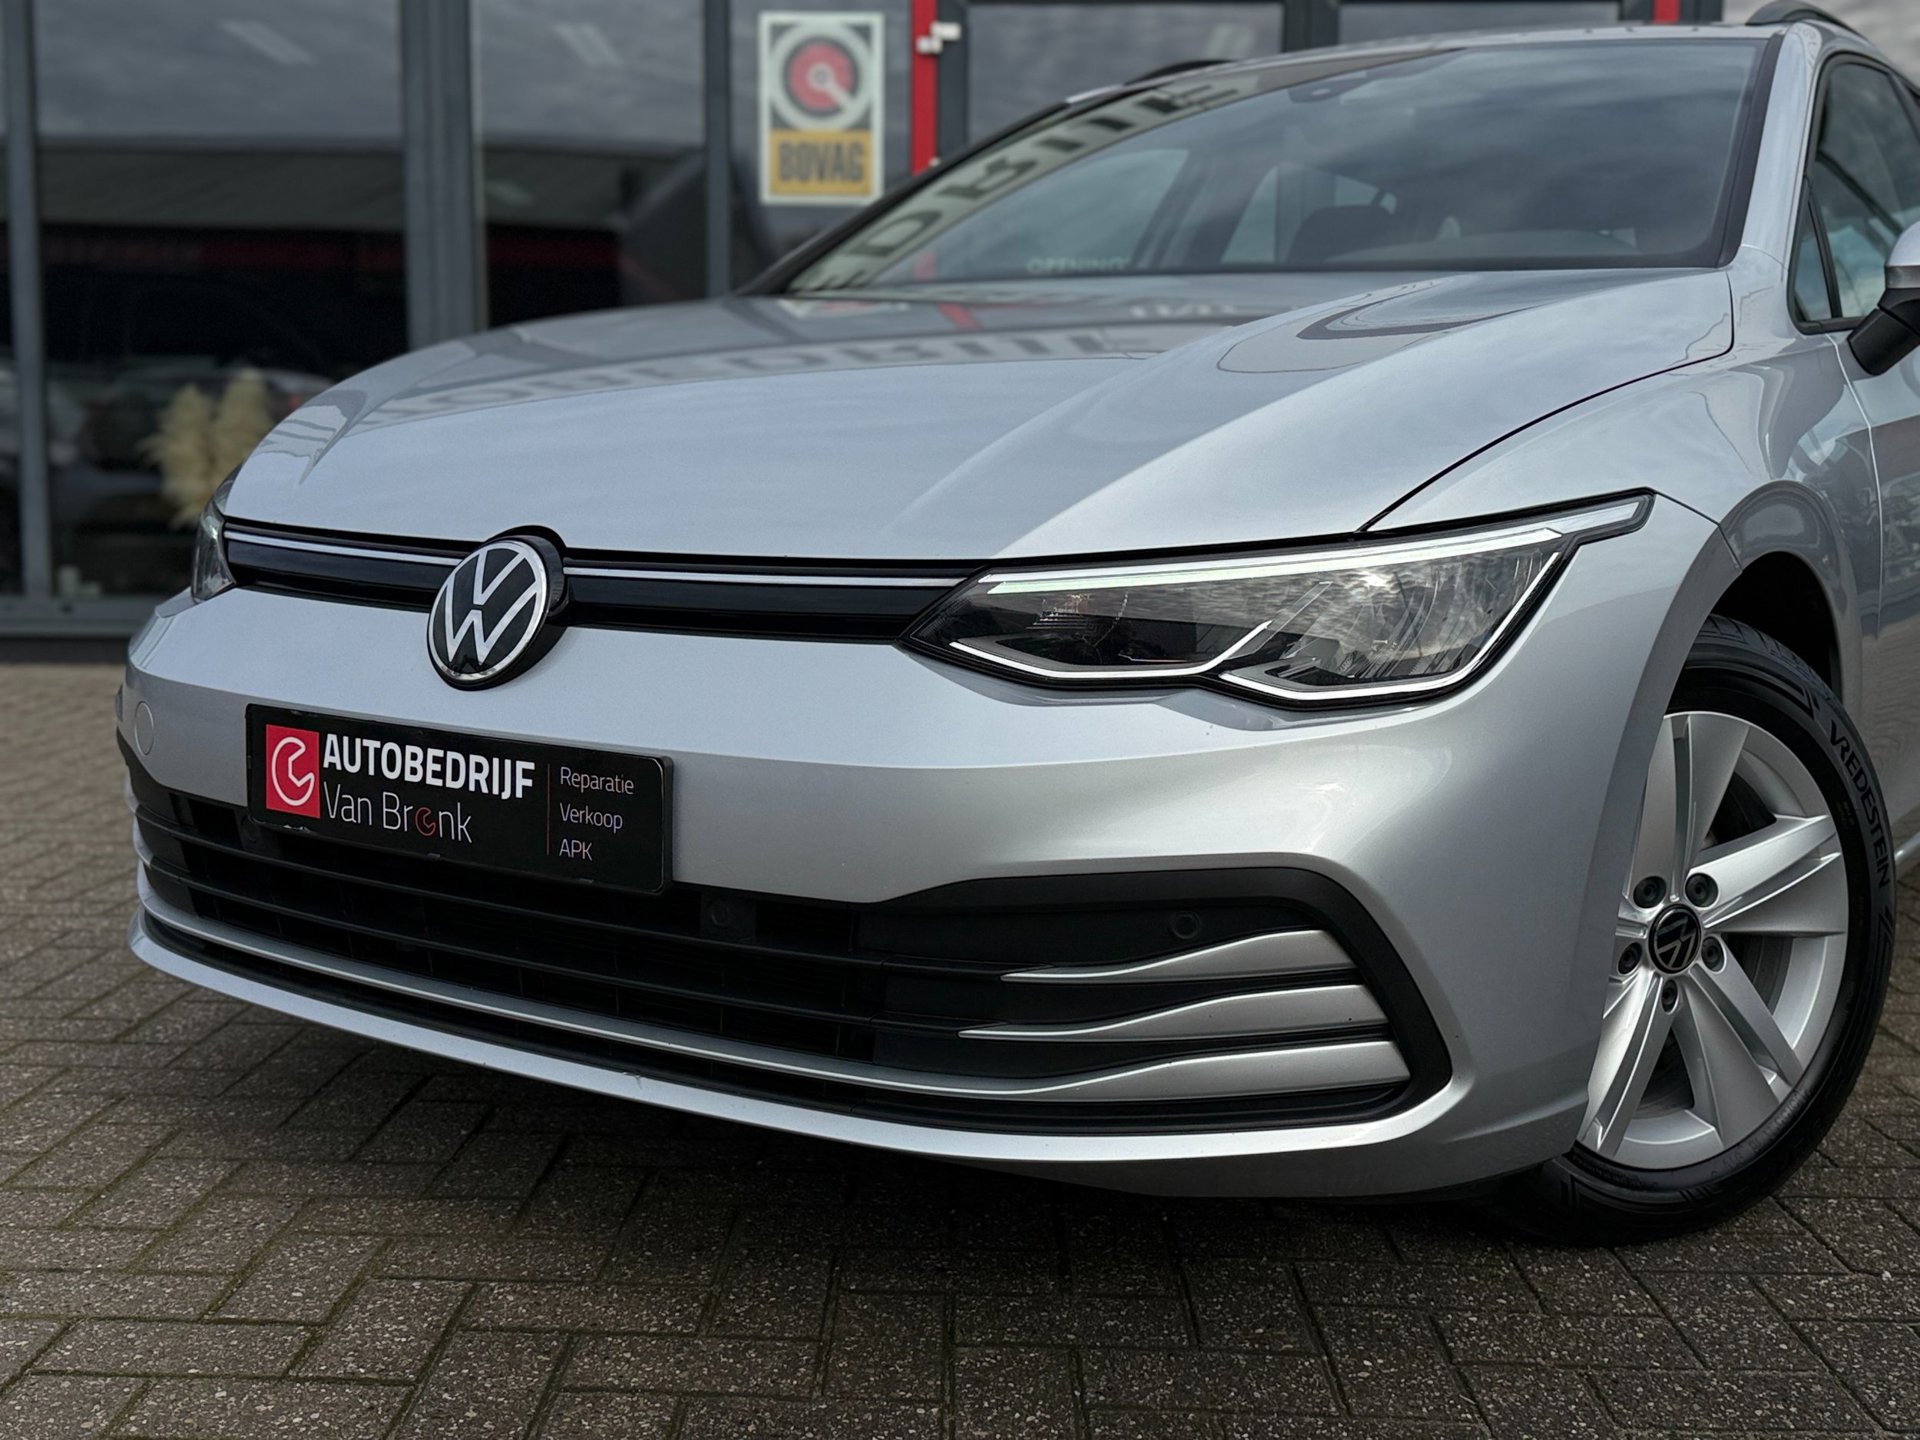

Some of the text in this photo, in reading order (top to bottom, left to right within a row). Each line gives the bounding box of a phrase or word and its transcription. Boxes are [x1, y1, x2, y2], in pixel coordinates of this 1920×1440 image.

[778, 141, 865, 183] BOVAG
[323, 733, 536, 800] AUTOBEDRIJF
[559, 766, 635, 796] Reparatie
[323, 780, 372, 826] Van
[559, 802, 623, 834] Verkoop
[1829, 719, 1891, 889] VREDESTEIN
[559, 838, 593, 861] APK
